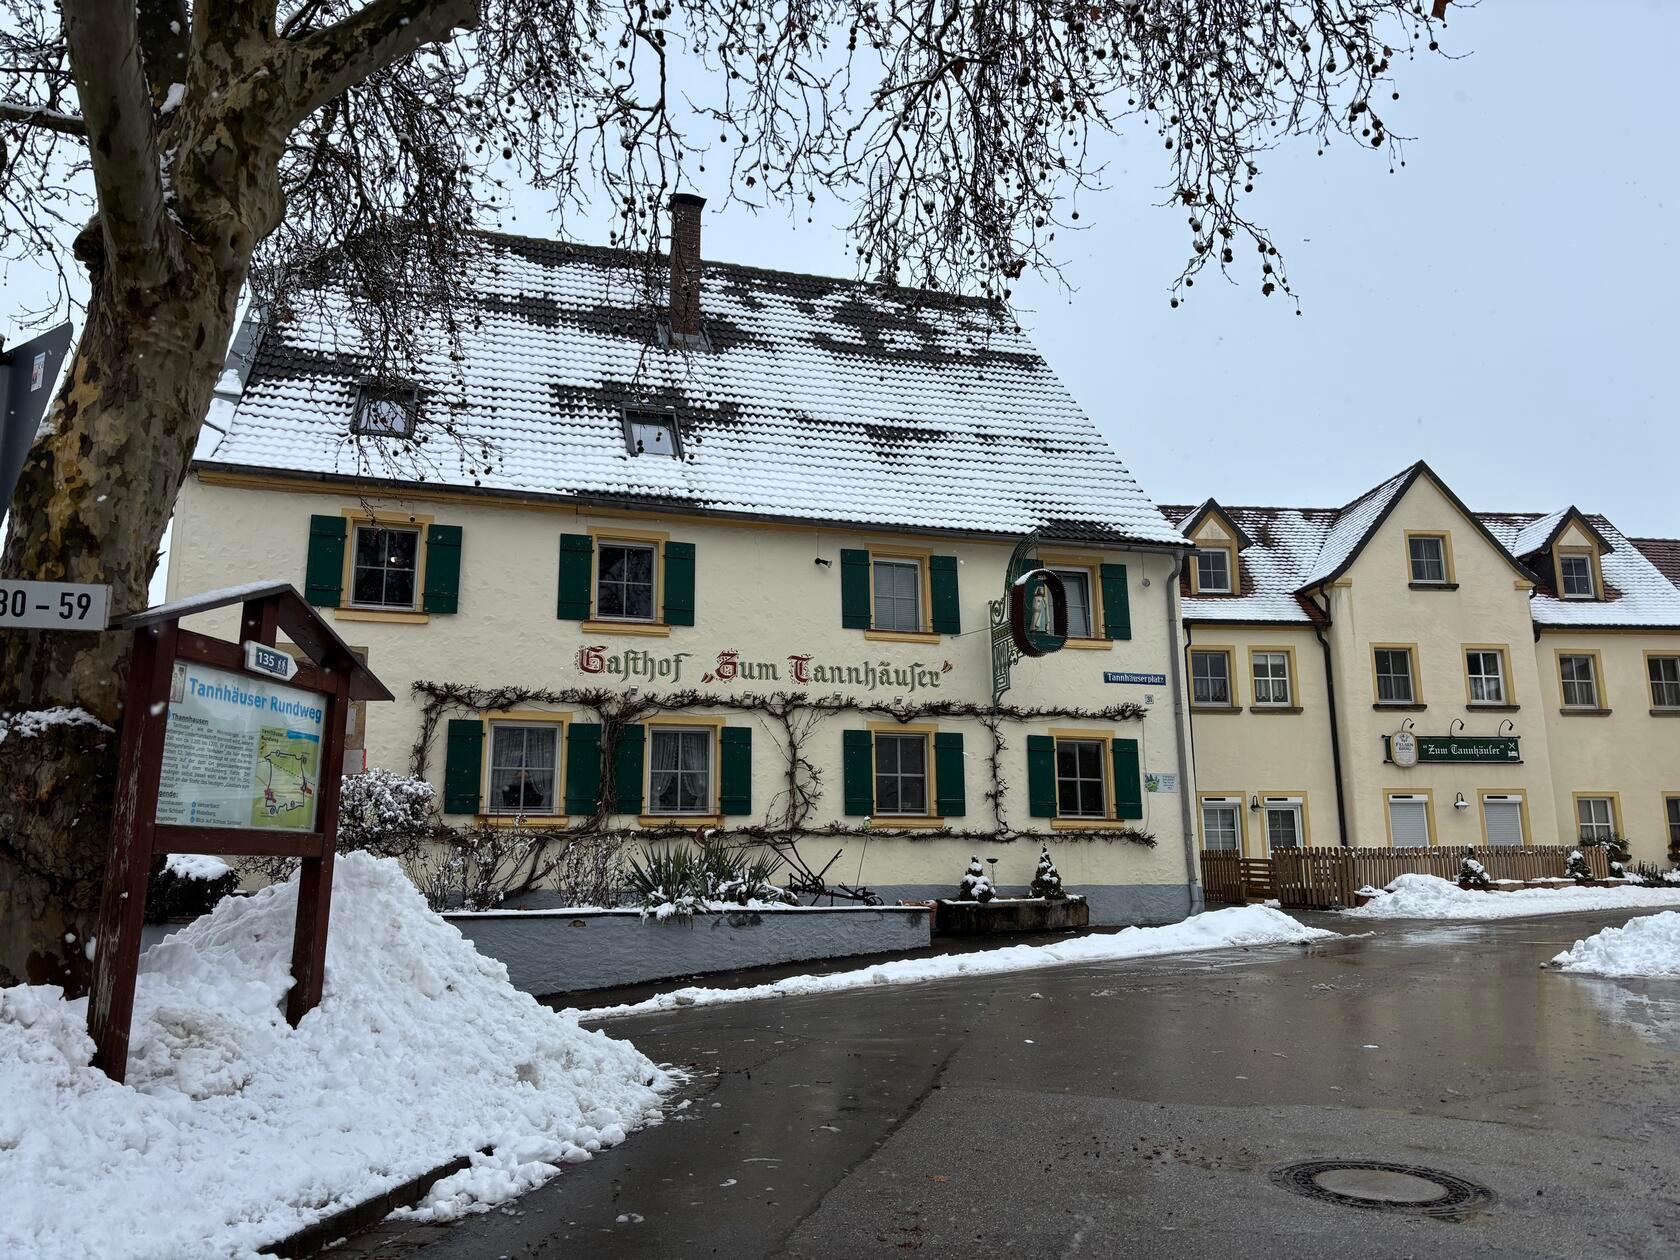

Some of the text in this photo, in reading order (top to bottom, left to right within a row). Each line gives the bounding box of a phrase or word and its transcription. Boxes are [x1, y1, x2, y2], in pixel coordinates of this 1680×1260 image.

[58, 592, 92, 620] 59
[258, 651, 275, 667] 135
[1107, 673, 1164, 684] Tannhäuserplatz
[189, 678, 323, 724] Tannhäuser Rundweg
[172, 712, 209, 727] Thannhausen
